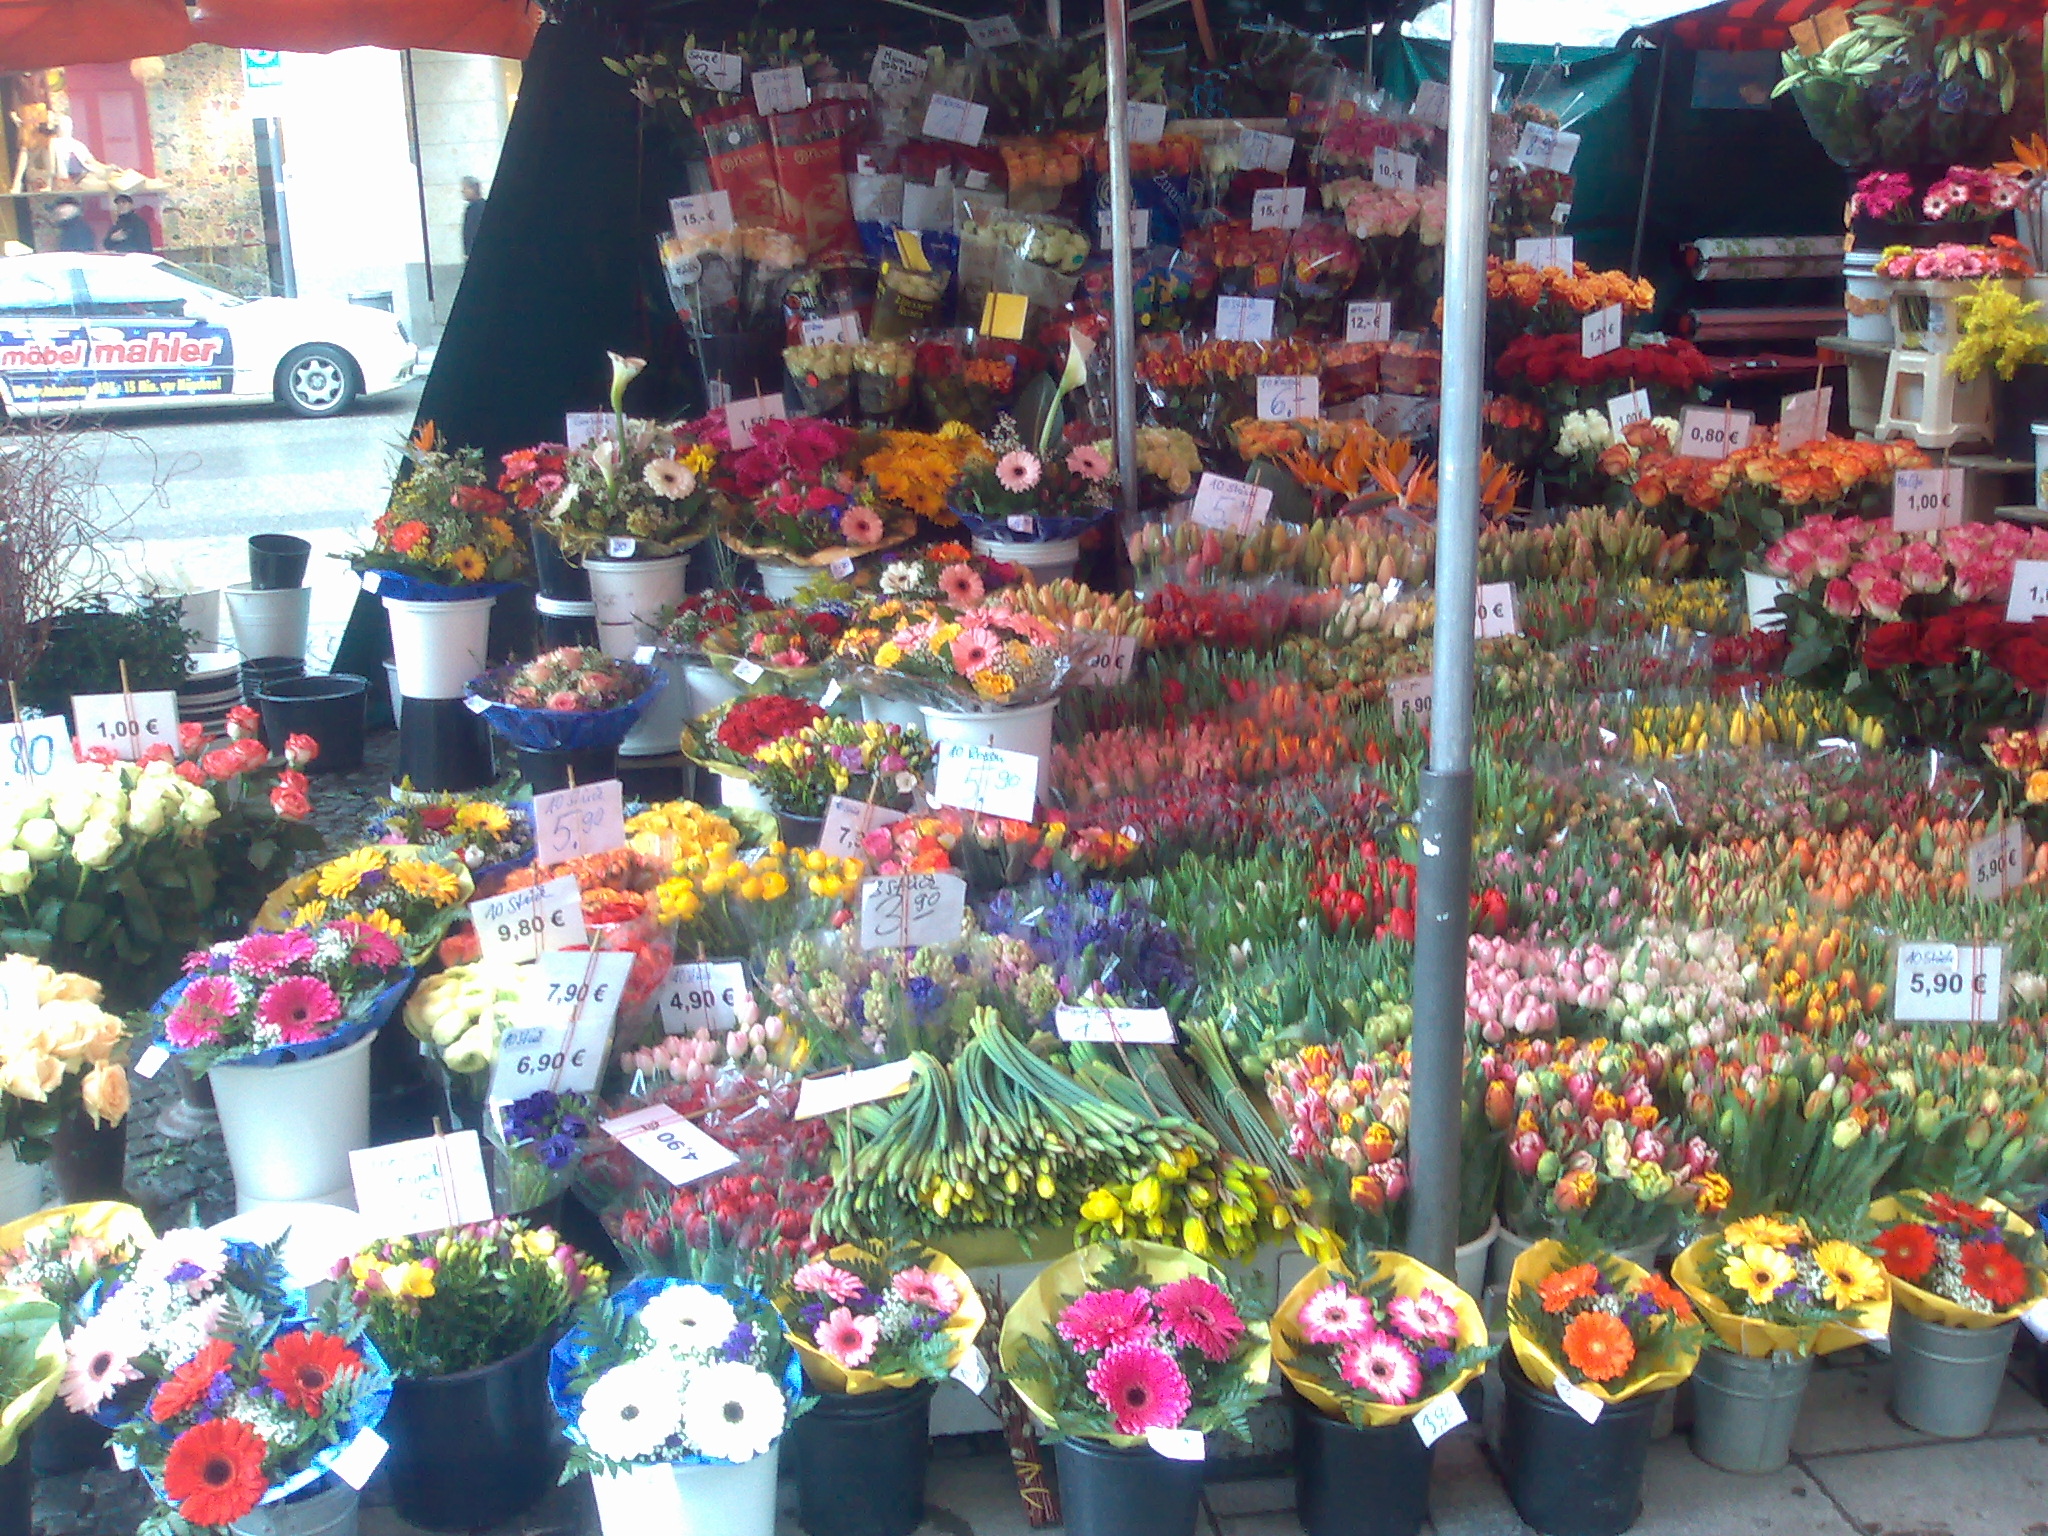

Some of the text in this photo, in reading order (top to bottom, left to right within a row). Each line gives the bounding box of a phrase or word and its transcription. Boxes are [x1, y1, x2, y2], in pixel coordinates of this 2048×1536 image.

[2, 337, 217, 366] möbel mahler
[1691, 427, 1739, 444] 0,80 €
[1908, 493, 1951, 511] 1,00 €
[2030, 586, 2048, 603] 1,
[97, 718, 159, 740] 1,00 €
[498, 909, 565, 941] 9,80 €
[547, 983, 608, 1005] 7,90 €
[1910, 973, 1987, 997] 5,90 €
[670, 987, 734, 1013] 4,90 €
[517, 1048, 586, 1075] 6,90 €
